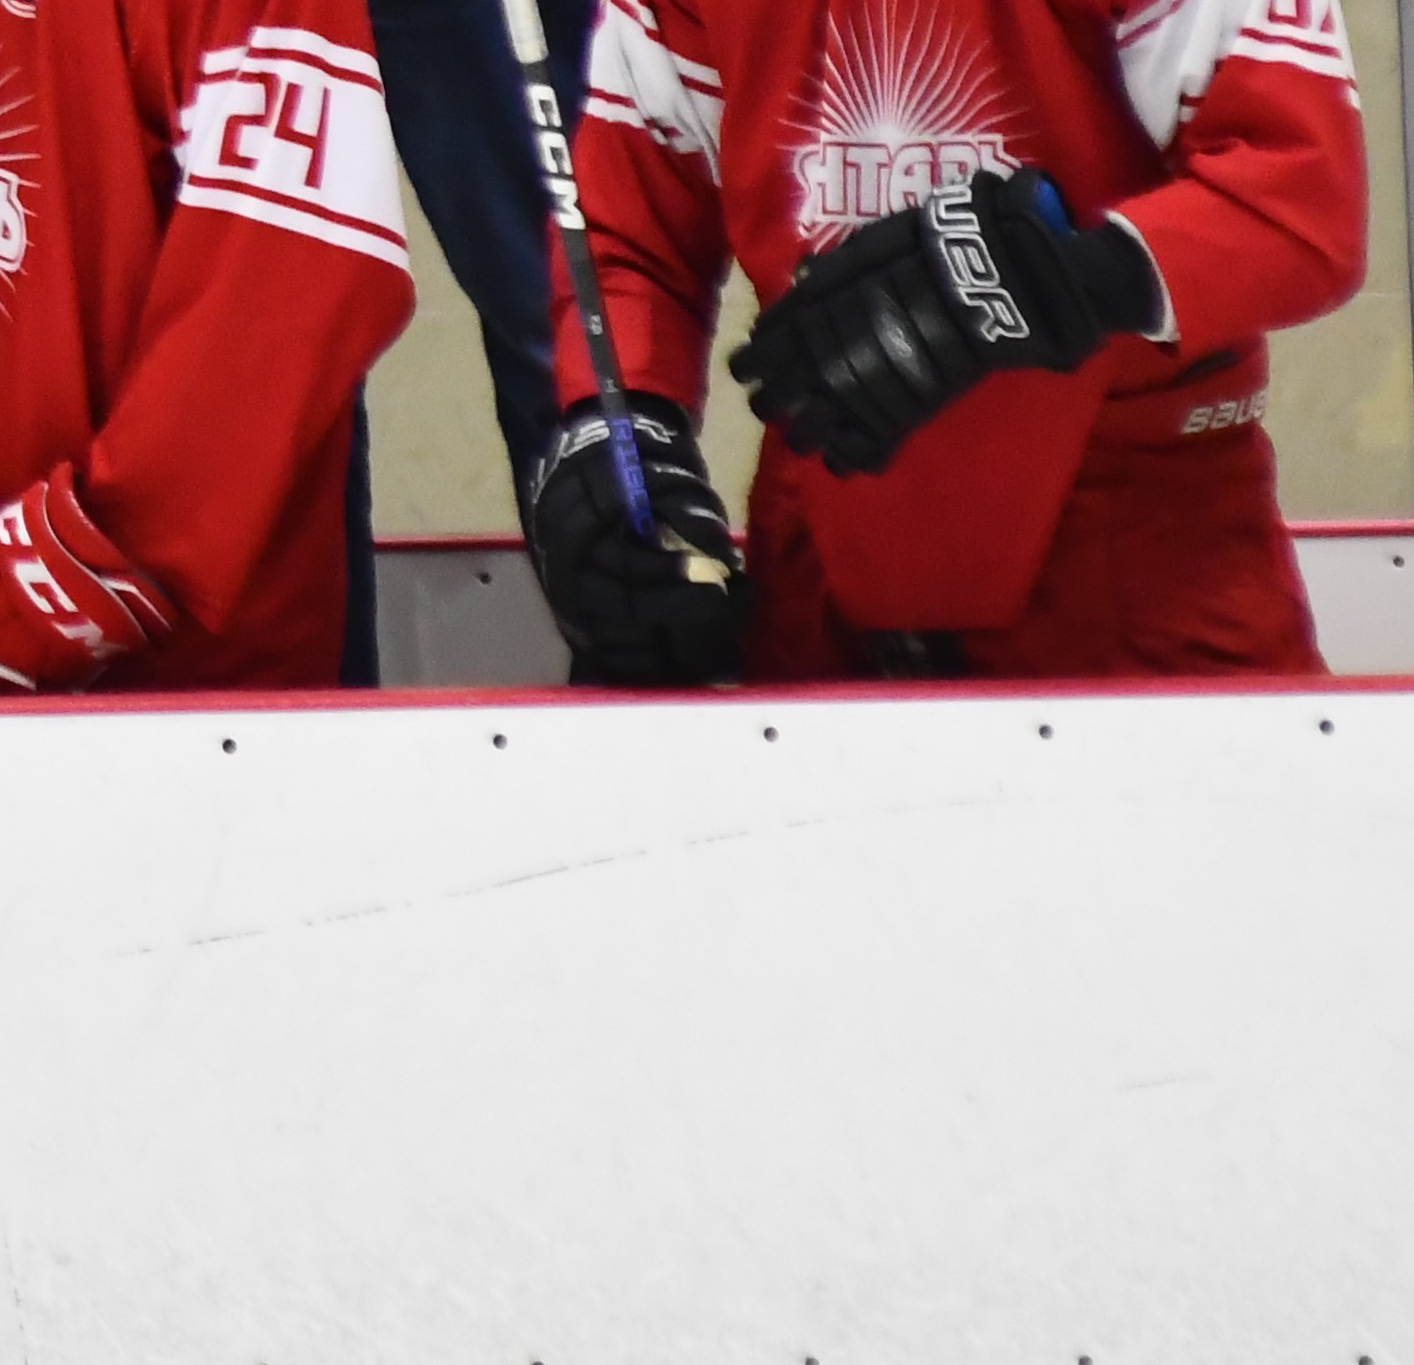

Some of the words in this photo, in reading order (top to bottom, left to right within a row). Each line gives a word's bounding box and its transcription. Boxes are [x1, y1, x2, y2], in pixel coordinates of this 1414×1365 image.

[219, 72, 331, 189] 24
[526, 84, 587, 230] CCM
[931, 182, 1031, 342] UER
